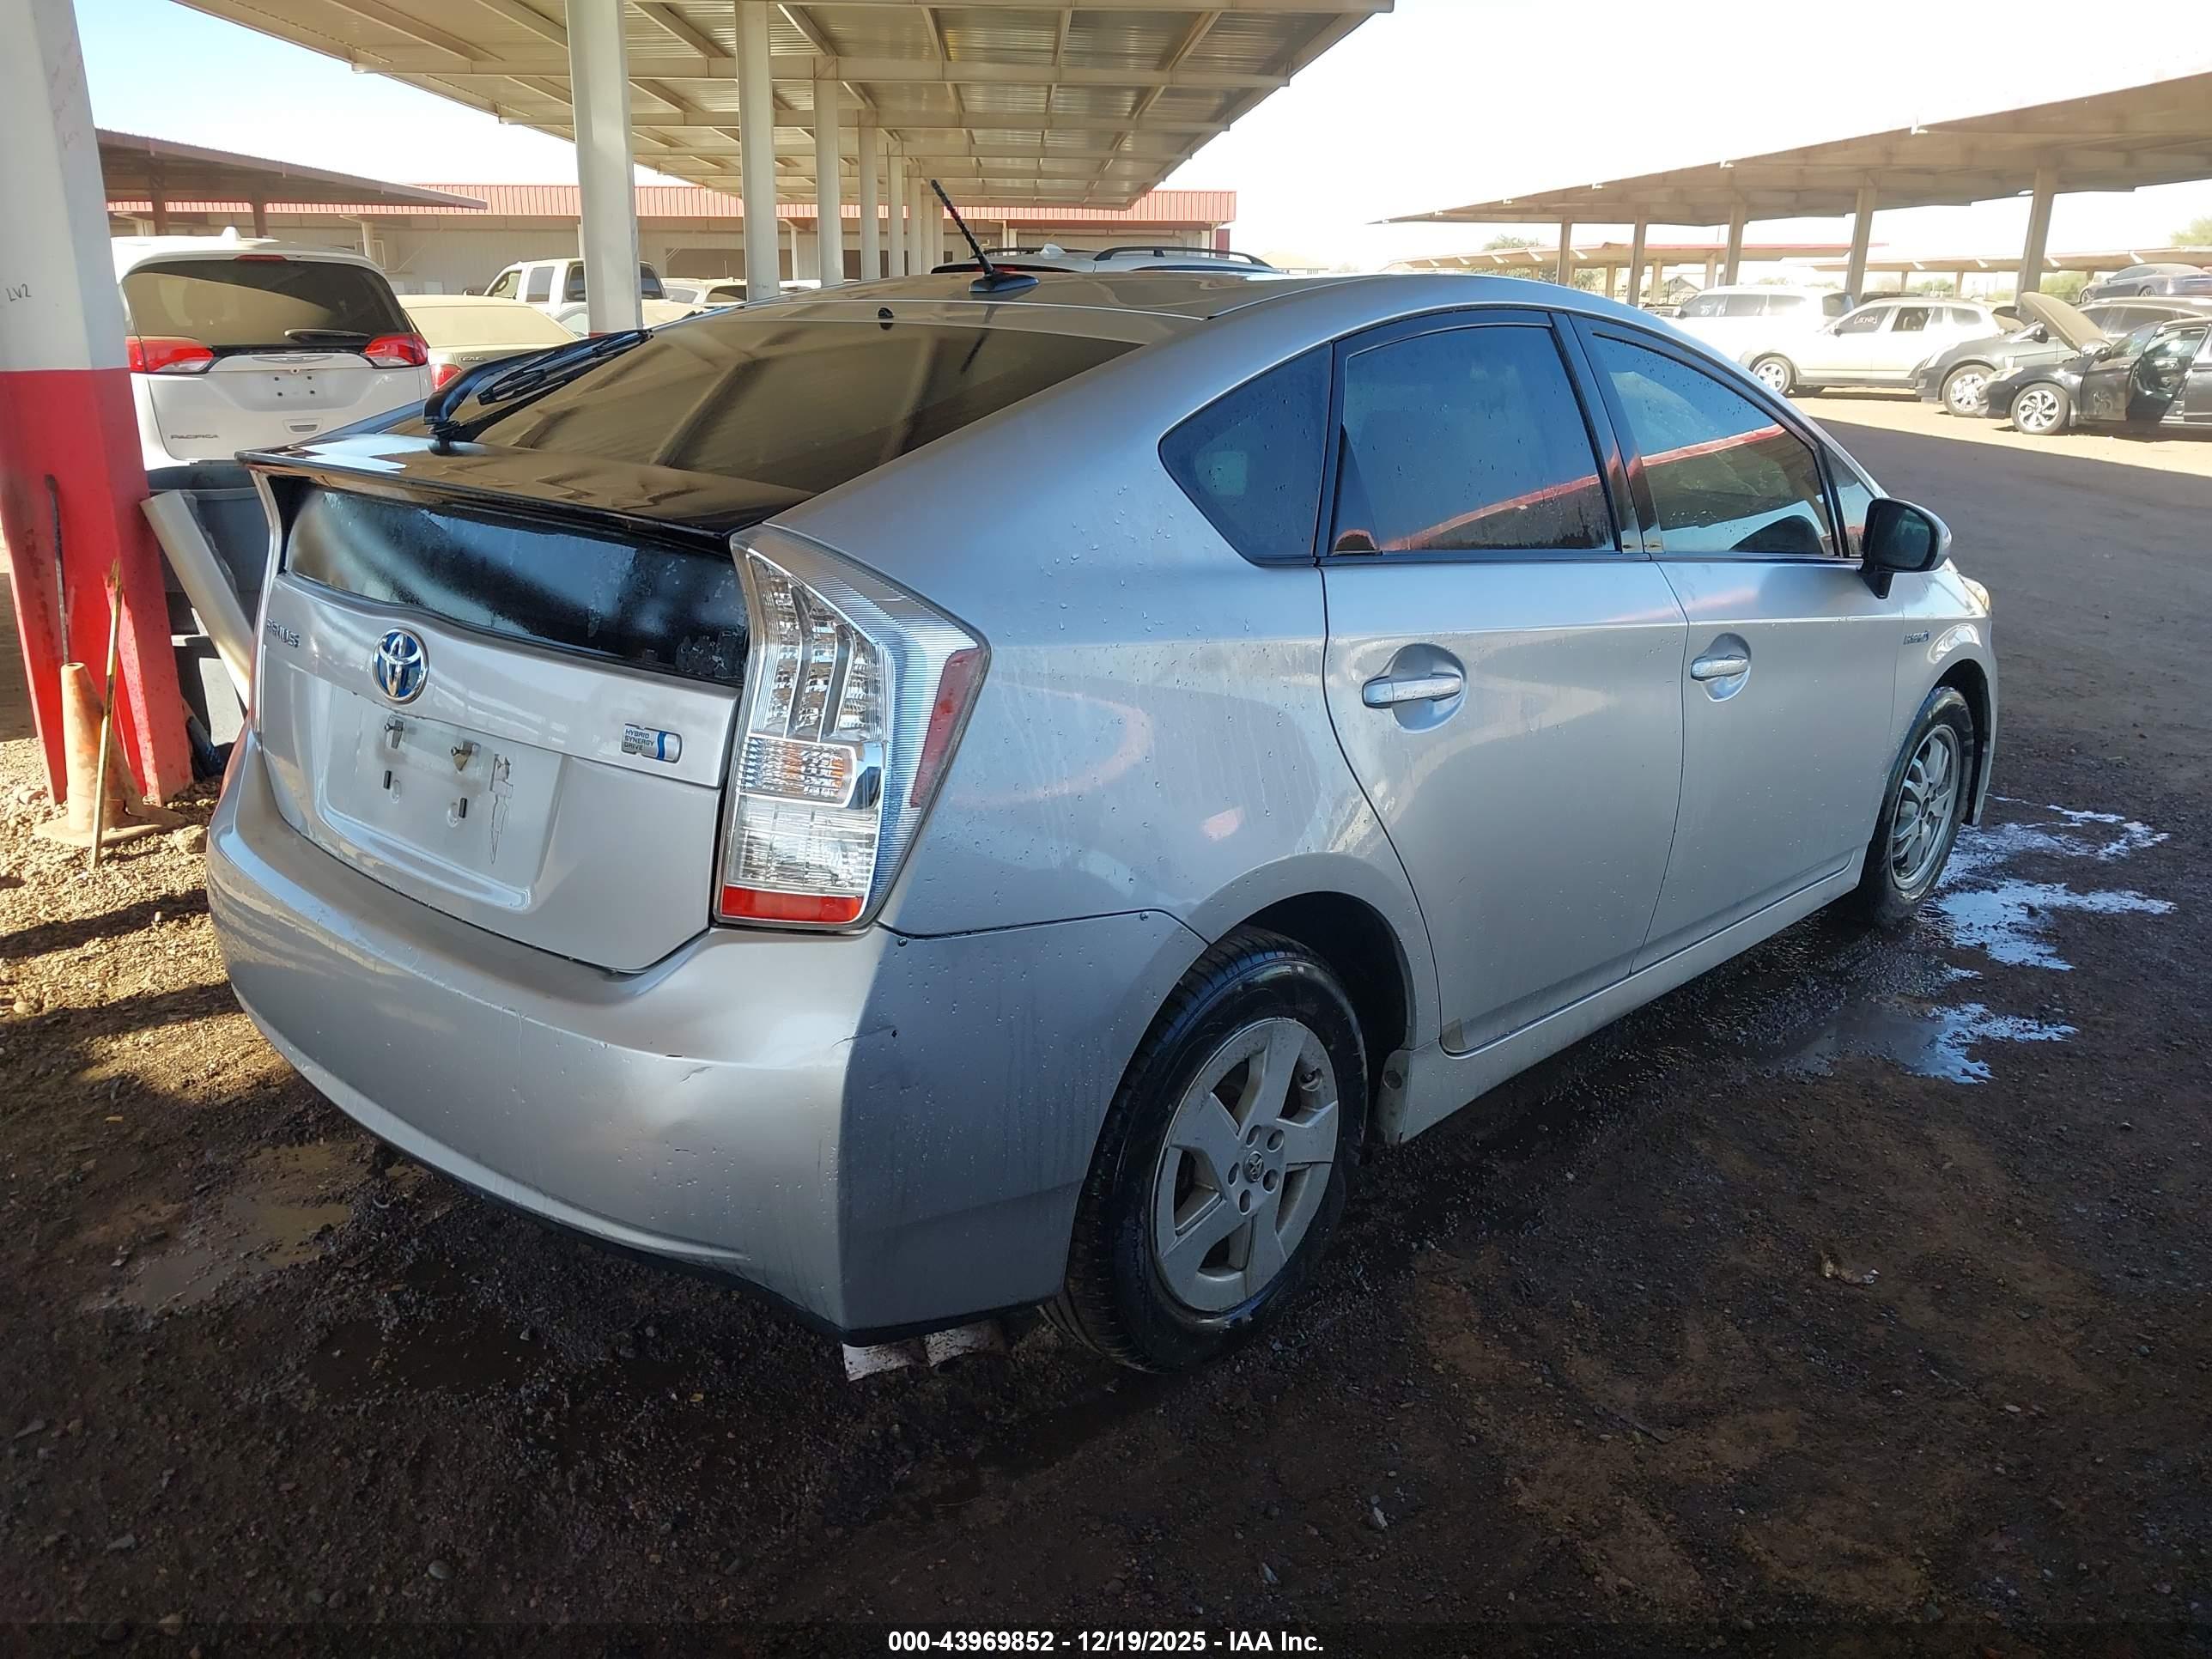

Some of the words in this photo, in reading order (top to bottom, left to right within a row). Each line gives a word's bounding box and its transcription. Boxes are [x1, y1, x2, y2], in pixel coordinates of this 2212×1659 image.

[5, 283, 32, 301] LV2
[266, 618, 300, 648] PRIUS
[624, 728, 650, 739] HYBRID
[623, 741, 643, 750] DRIVE
[624, 735, 654, 746] SYNERGY
